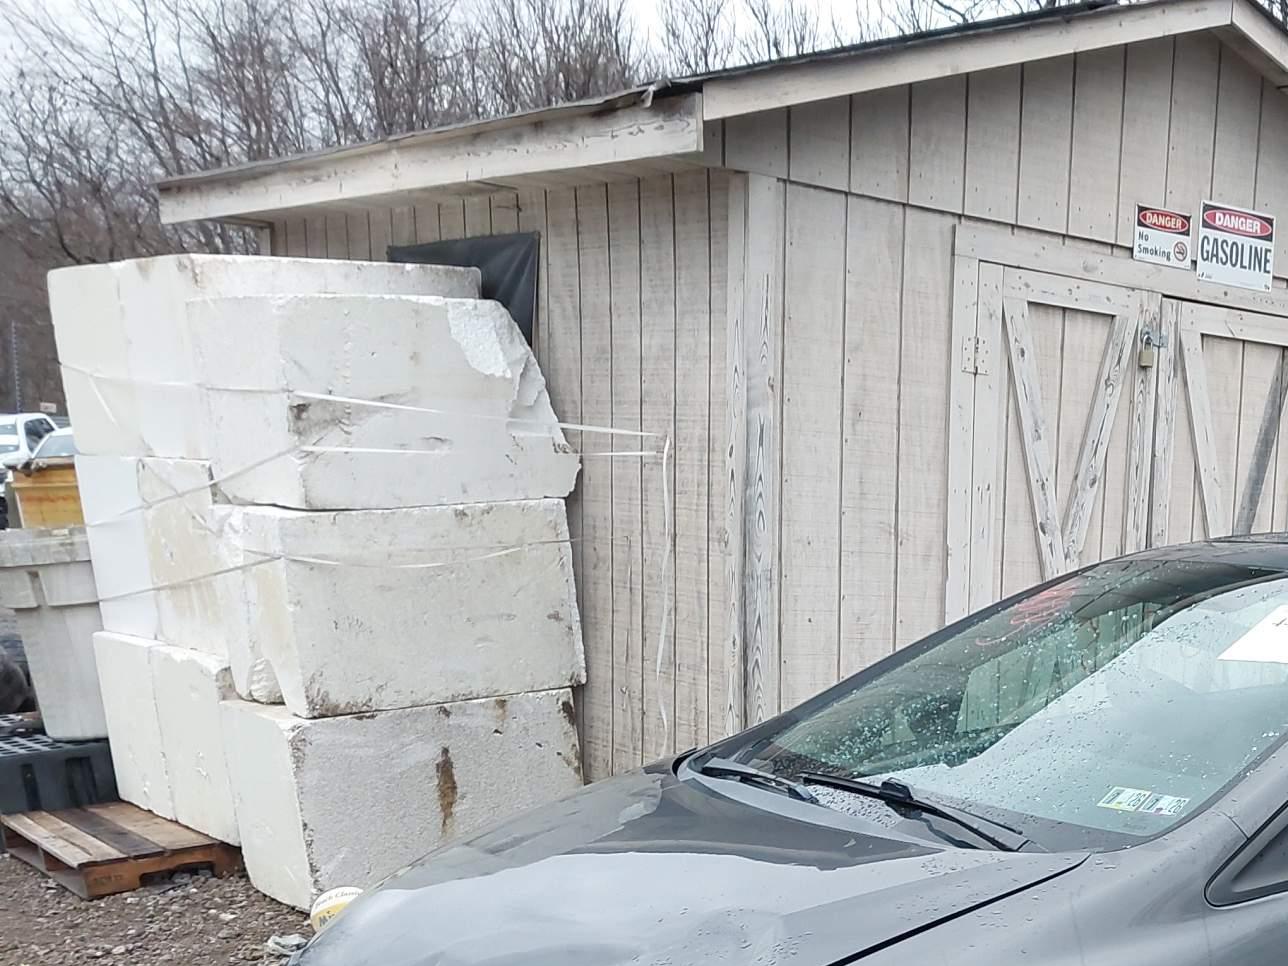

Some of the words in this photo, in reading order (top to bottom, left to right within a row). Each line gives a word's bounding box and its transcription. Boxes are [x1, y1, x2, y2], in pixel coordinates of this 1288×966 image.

[1146, 214, 1182, 229] DANGER
[1215, 212, 1261, 234] DANGER
[1138, 231, 1149, 242] No
[1138, 245, 1171, 262] Smoking
[1200, 235, 1272, 274] GASOLINE
